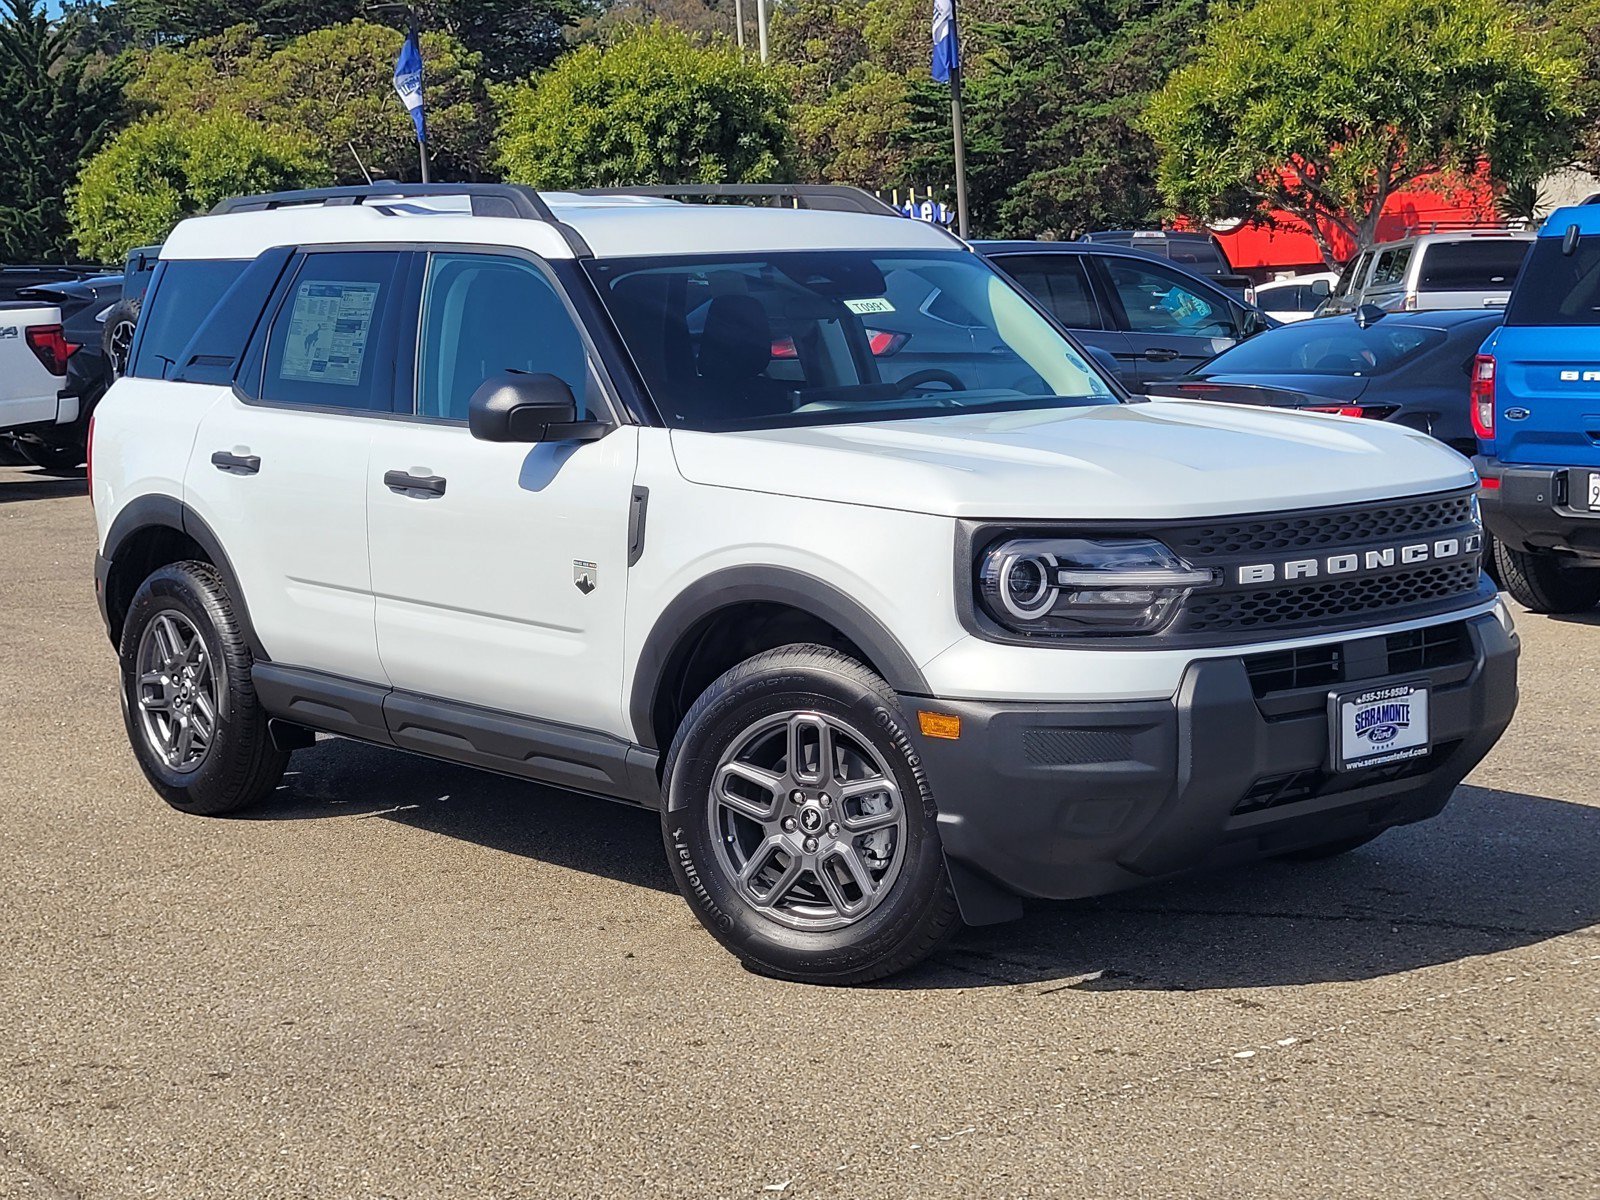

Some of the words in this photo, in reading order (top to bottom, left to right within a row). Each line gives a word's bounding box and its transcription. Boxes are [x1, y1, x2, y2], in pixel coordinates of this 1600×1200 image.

[852, 302, 888, 312] T0991
[1239, 539, 1459, 585] BRONCO
[1355, 704, 1410, 732] SERRAMONTE
[1372, 726, 1393, 741] Ford
[1345, 748, 1428, 770] www.serramonteford.com
